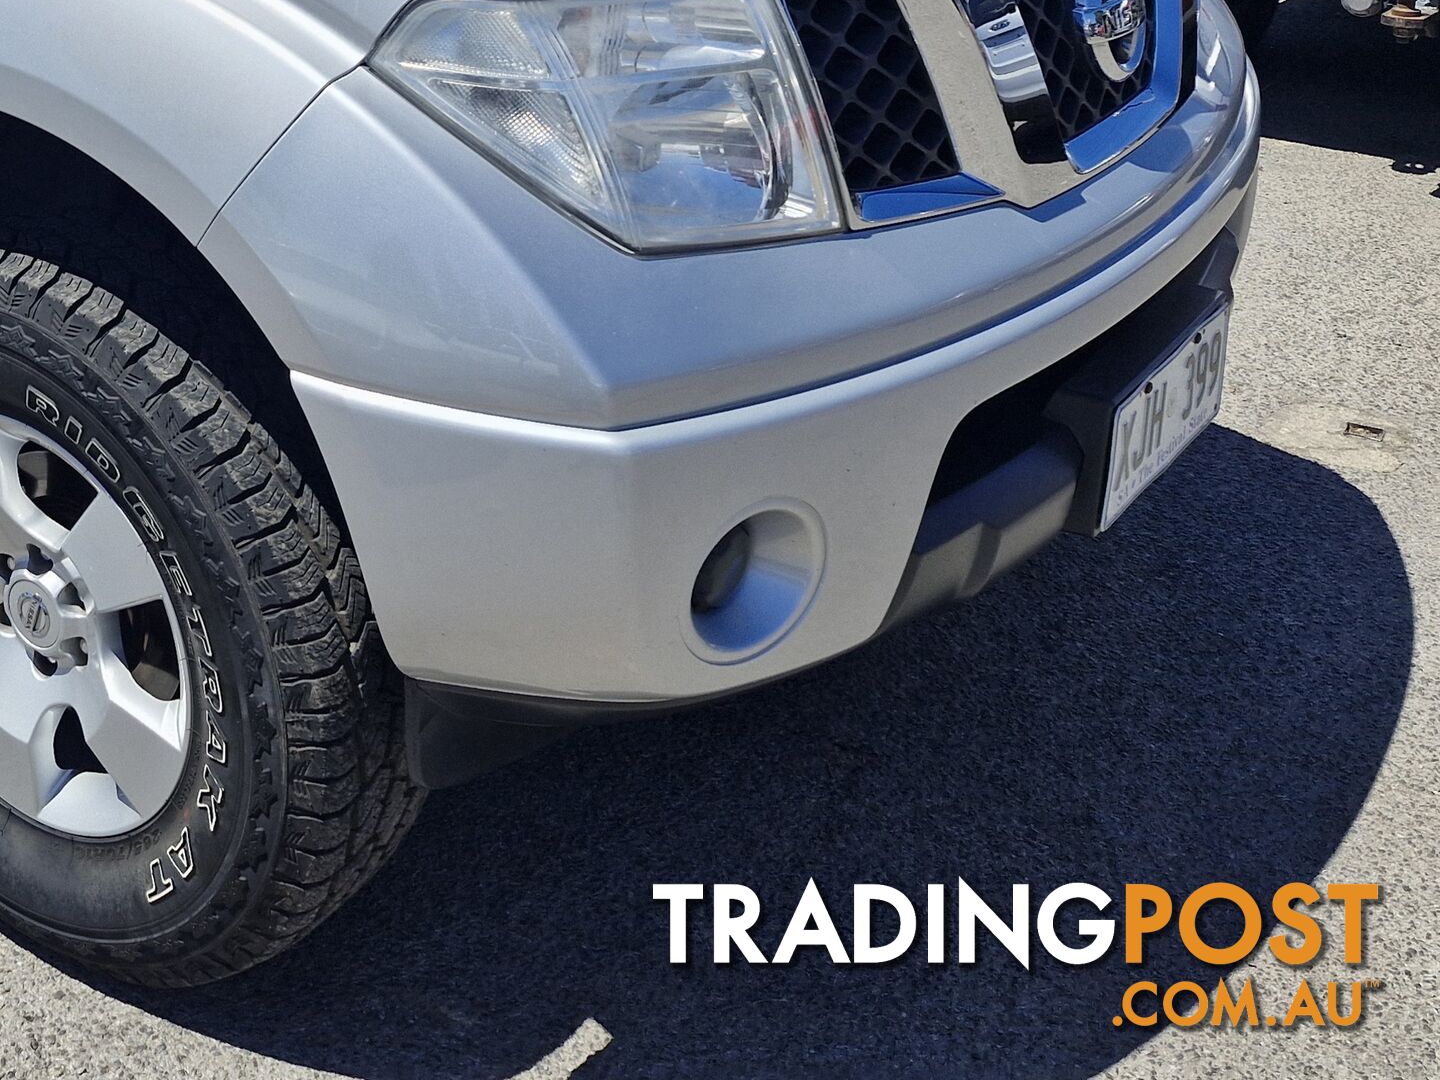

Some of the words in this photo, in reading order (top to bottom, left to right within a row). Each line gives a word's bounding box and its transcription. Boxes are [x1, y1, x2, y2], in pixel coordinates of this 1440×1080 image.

[1112, 381, 1168, 493] XJH
[1181, 328, 1222, 422] 399
[25, 384, 228, 831] RIDGETRAK
[146, 826, 194, 902] AT
